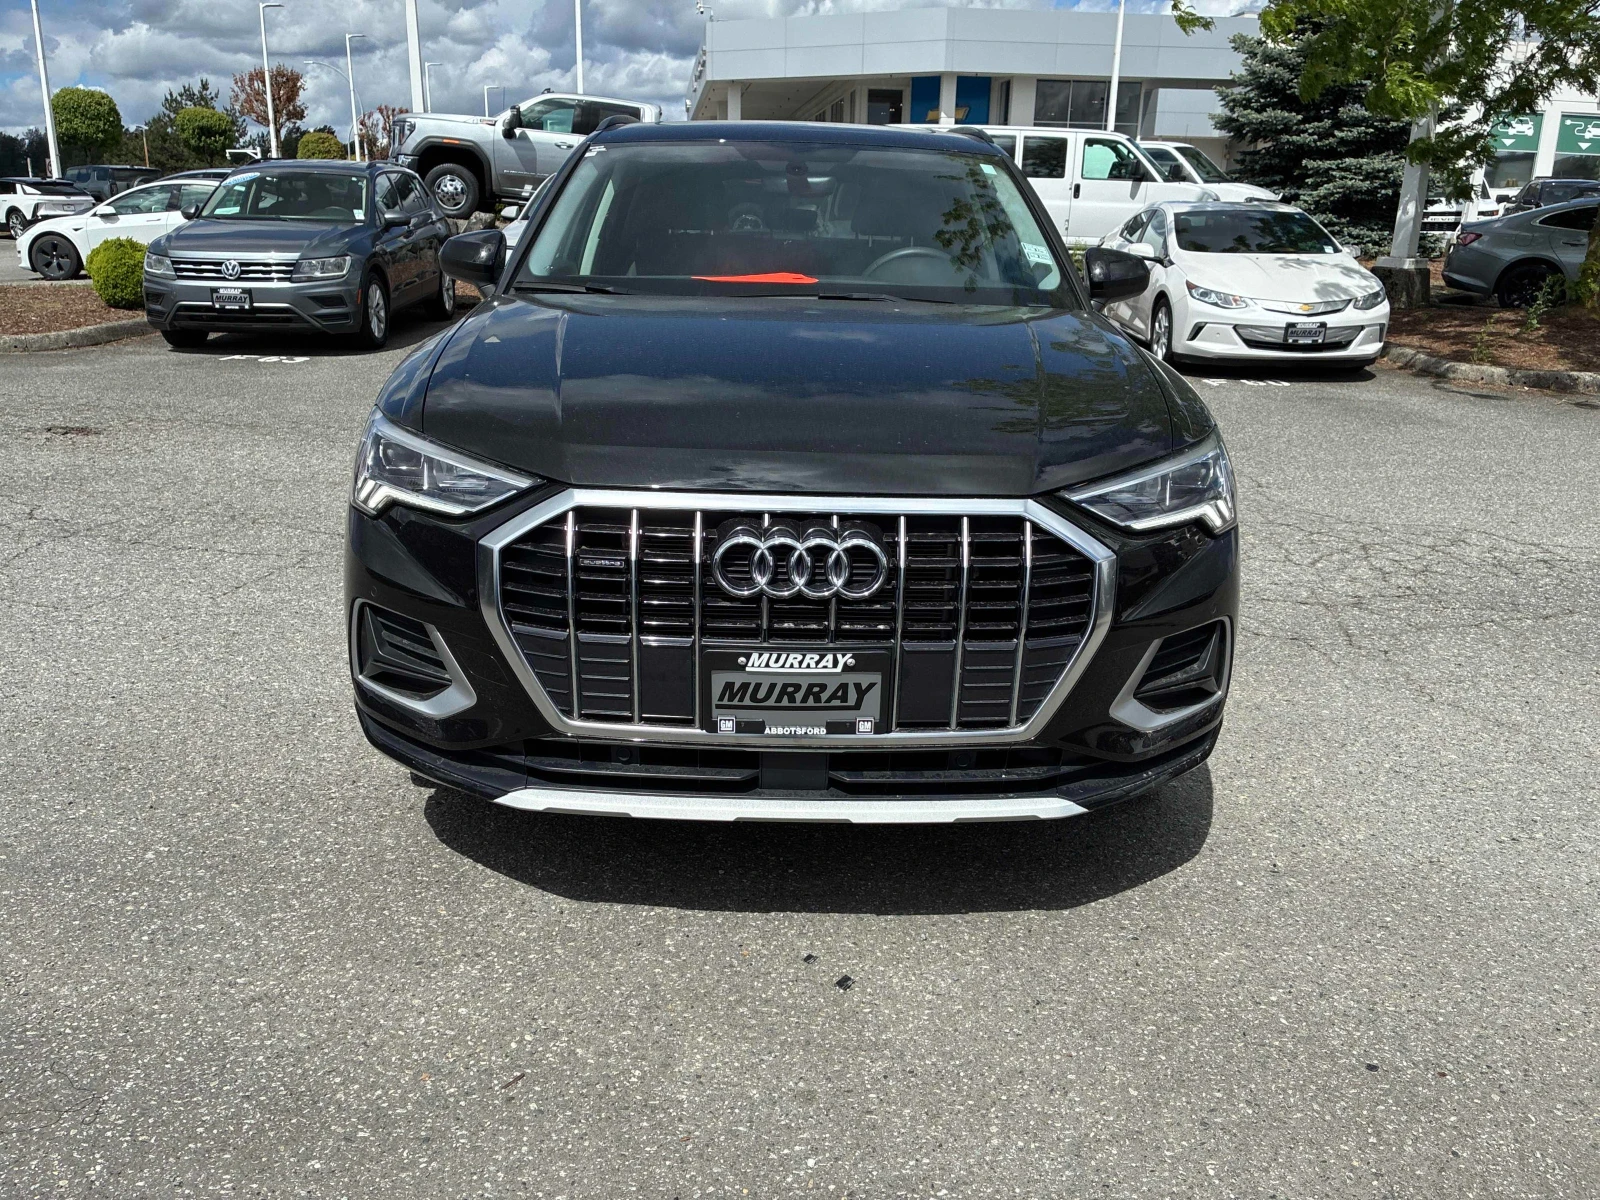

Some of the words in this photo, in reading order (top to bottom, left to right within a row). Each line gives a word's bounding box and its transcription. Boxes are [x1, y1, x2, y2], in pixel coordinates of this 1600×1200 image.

[215, 295, 248, 303] MURRAY
[1289, 329, 1323, 338] MURRAY
[746, 653, 852, 672] MURRAY
[715, 681, 878, 710] MURRAY
[719, 719, 734, 731] GM
[764, 727, 826, 735] ABBOTSFORD
[858, 720, 872, 732] GM
